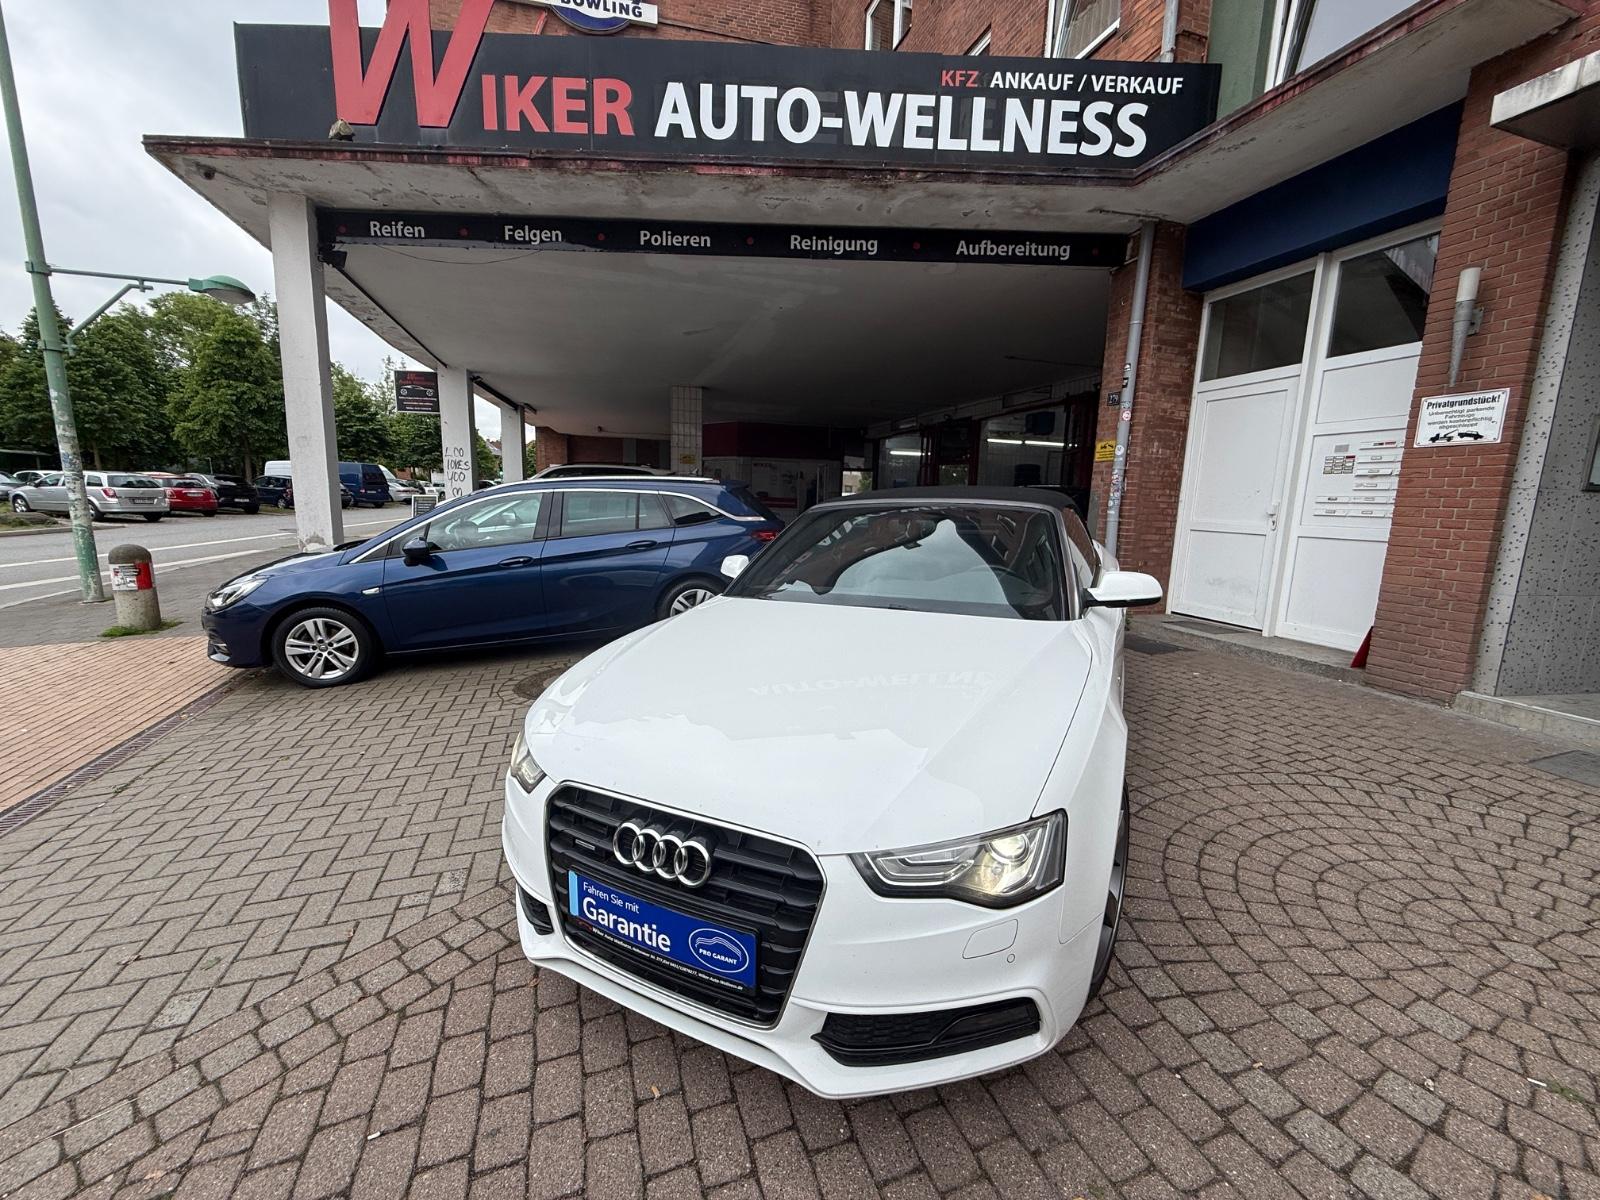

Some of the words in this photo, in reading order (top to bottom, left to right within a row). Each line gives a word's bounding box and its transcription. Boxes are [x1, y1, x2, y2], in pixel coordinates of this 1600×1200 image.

[328, 0, 634, 137] WIKER
[654, 82, 1148, 158] AUTO-WELLNESS
[941, 70, 979, 88] KFZ
[990, 71, 1074, 92] ANKAUF
[1091, 75, 1184, 96] VERKAUF
[369, 220, 426, 240] Reifen
[503, 225, 563, 246] Felgen
[639, 230, 712, 248] Polieren
[789, 234, 879, 256] Reinigung
[955, 239, 1072, 261] Aufbereitung
[1426, 394, 1501, 409] Privatgrundstück!
[583, 881, 609, 901] Fahren
[610, 894, 623, 906] Sie
[625, 902, 640, 914] mit
[583, 896, 671, 952] Garantie
[699, 948, 712, 957] PRO
[712, 953, 737, 965] GARANT
